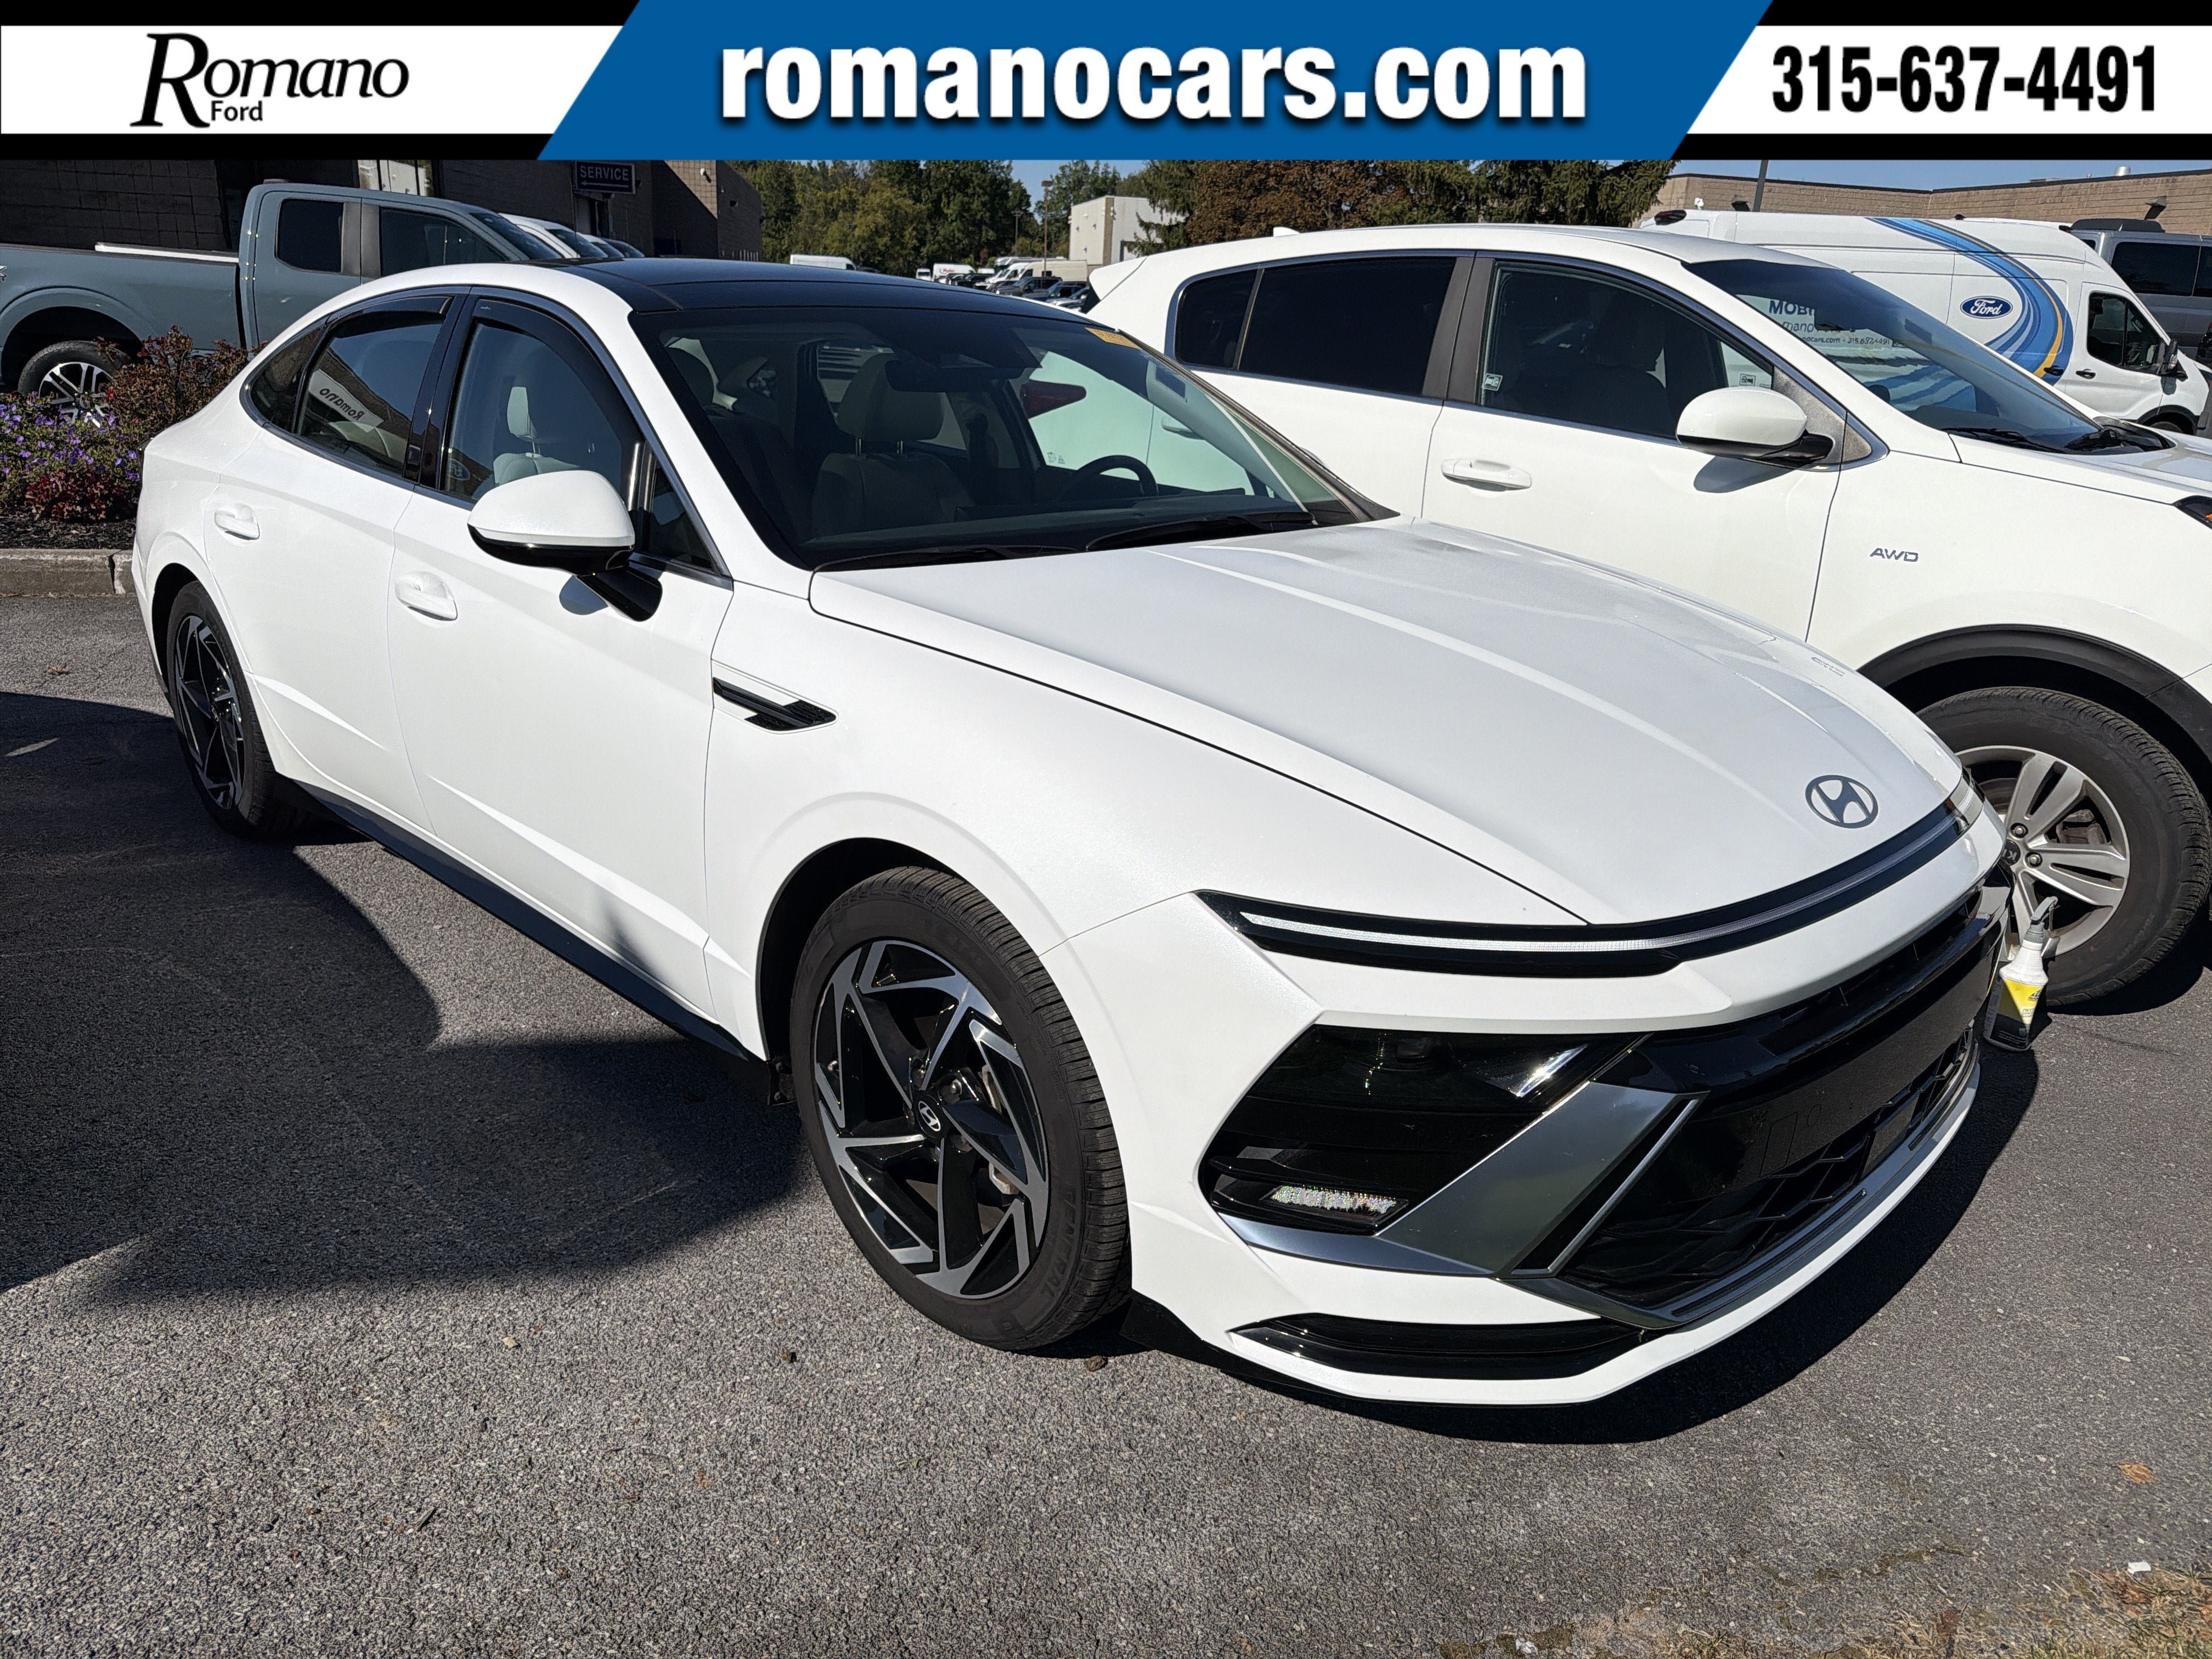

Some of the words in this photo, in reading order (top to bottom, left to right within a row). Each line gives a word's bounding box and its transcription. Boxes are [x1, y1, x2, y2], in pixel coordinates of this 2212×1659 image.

[580, 165, 629, 181] SERVICE
[1769, 300, 1812, 316] MOBI
[1970, 299, 2003, 315] Ford
[1782, 321, 1814, 332] mano
[1870, 548, 1919, 562] AWD
